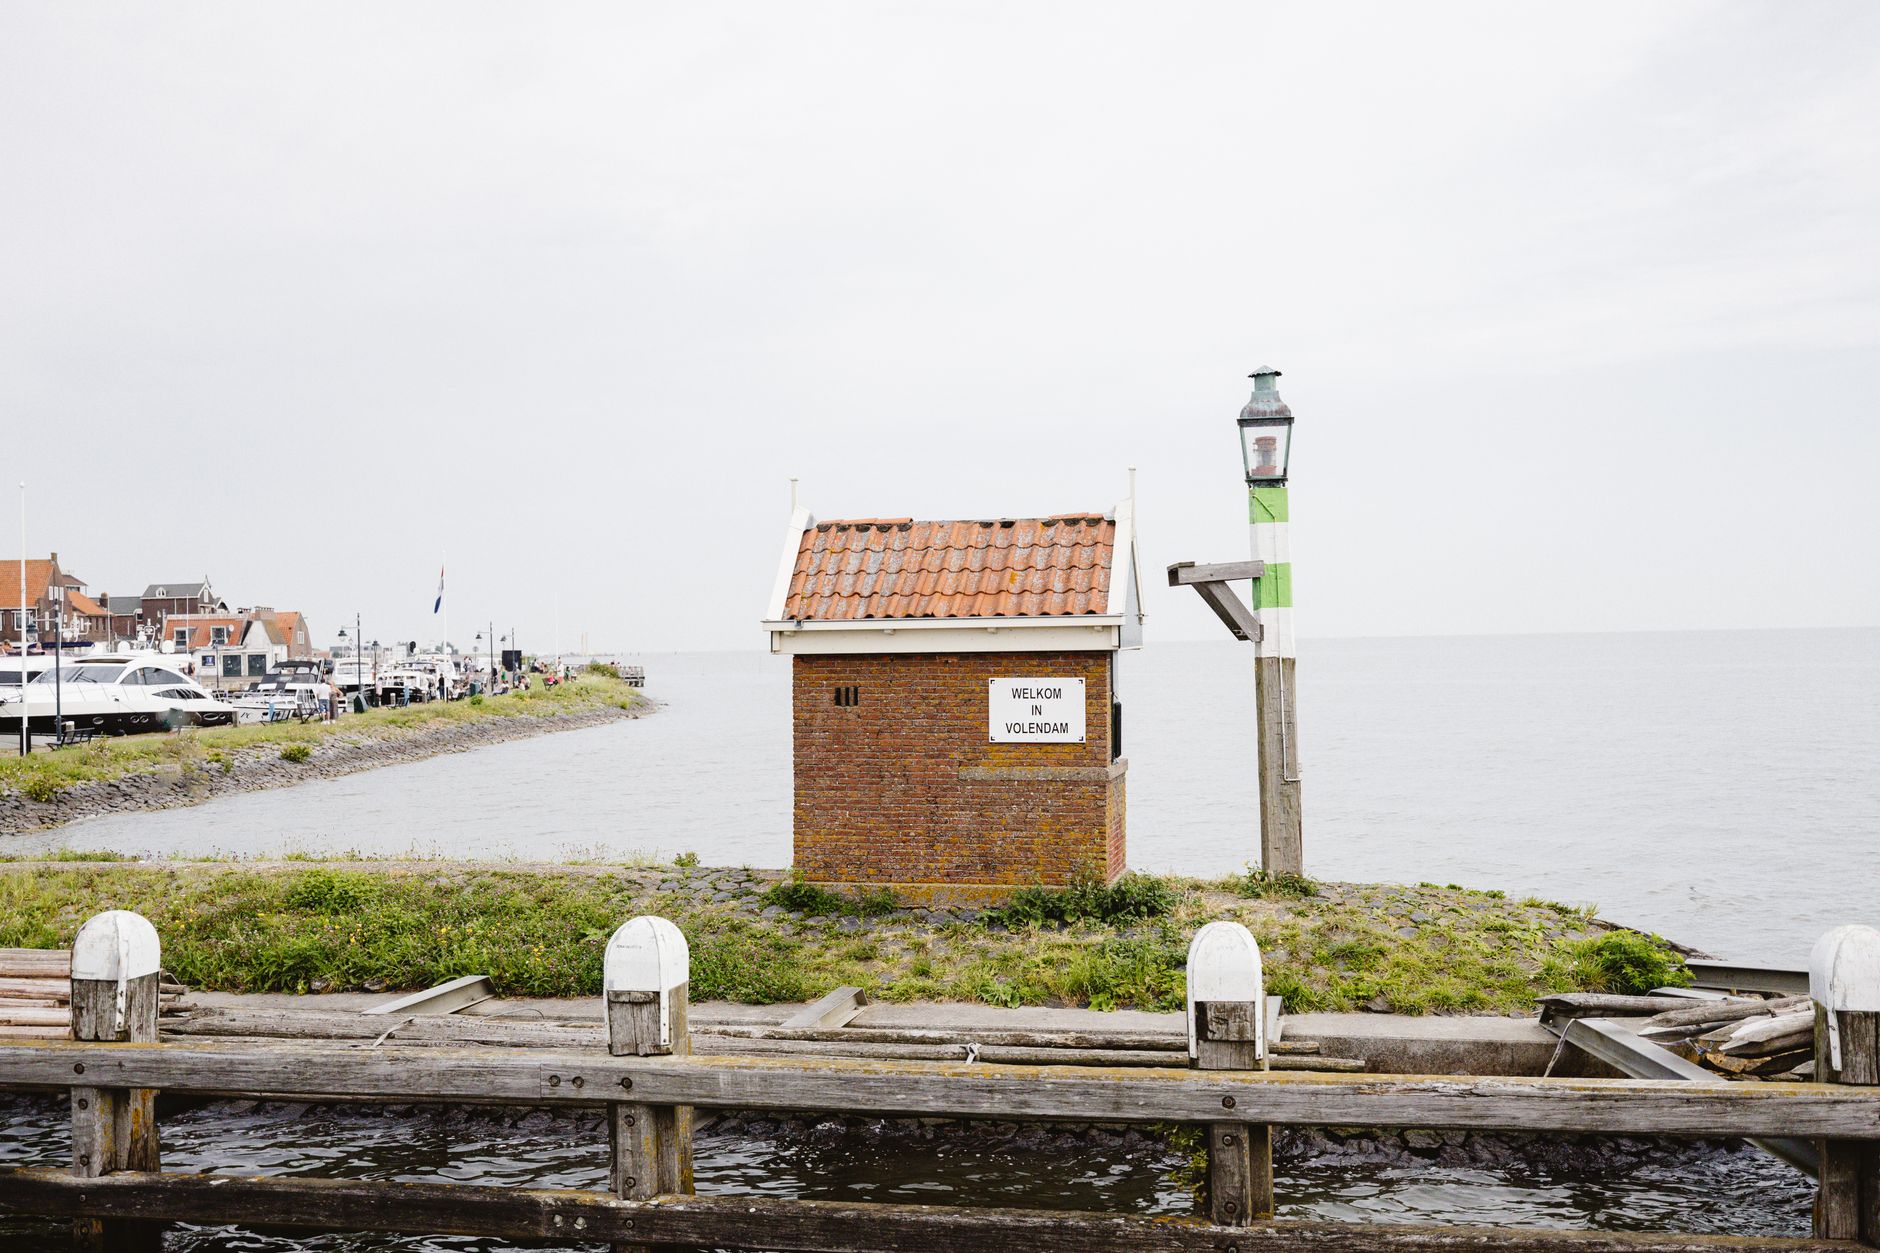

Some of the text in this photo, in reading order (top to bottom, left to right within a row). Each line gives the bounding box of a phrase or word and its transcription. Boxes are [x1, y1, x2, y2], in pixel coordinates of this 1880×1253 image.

[1011, 687, 1062, 699] WELKOM
[1031, 704, 1042, 716] IN
[1005, 722, 1069, 734] VOLENDAM
